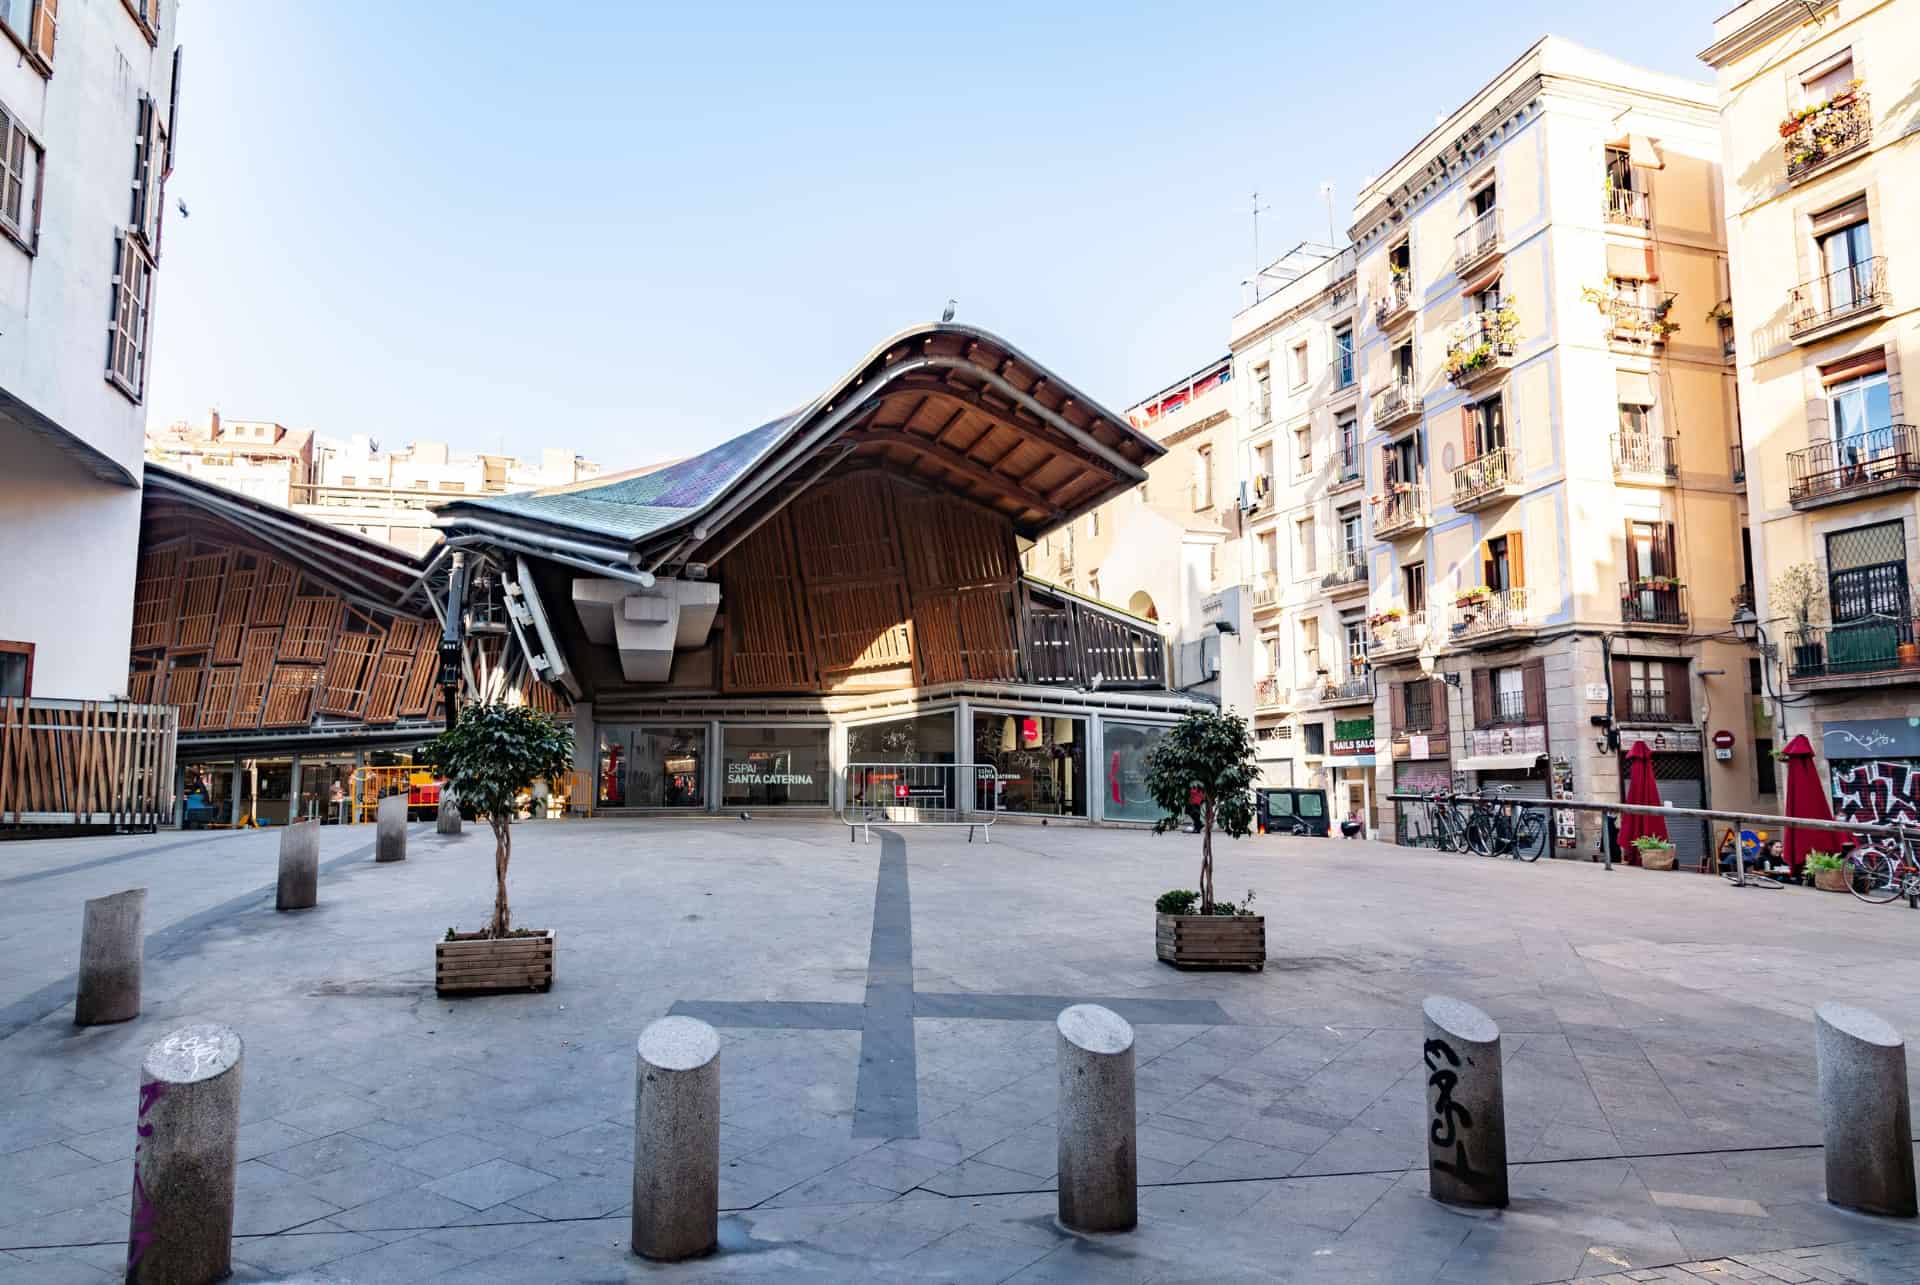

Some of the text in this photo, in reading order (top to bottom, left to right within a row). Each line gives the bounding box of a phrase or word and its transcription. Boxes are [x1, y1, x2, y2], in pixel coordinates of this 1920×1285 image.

[1333, 741, 1354, 750] NAILS
[728, 763, 757, 773] ESPAI
[727, 774, 813, 784] SANTA CATERINA
